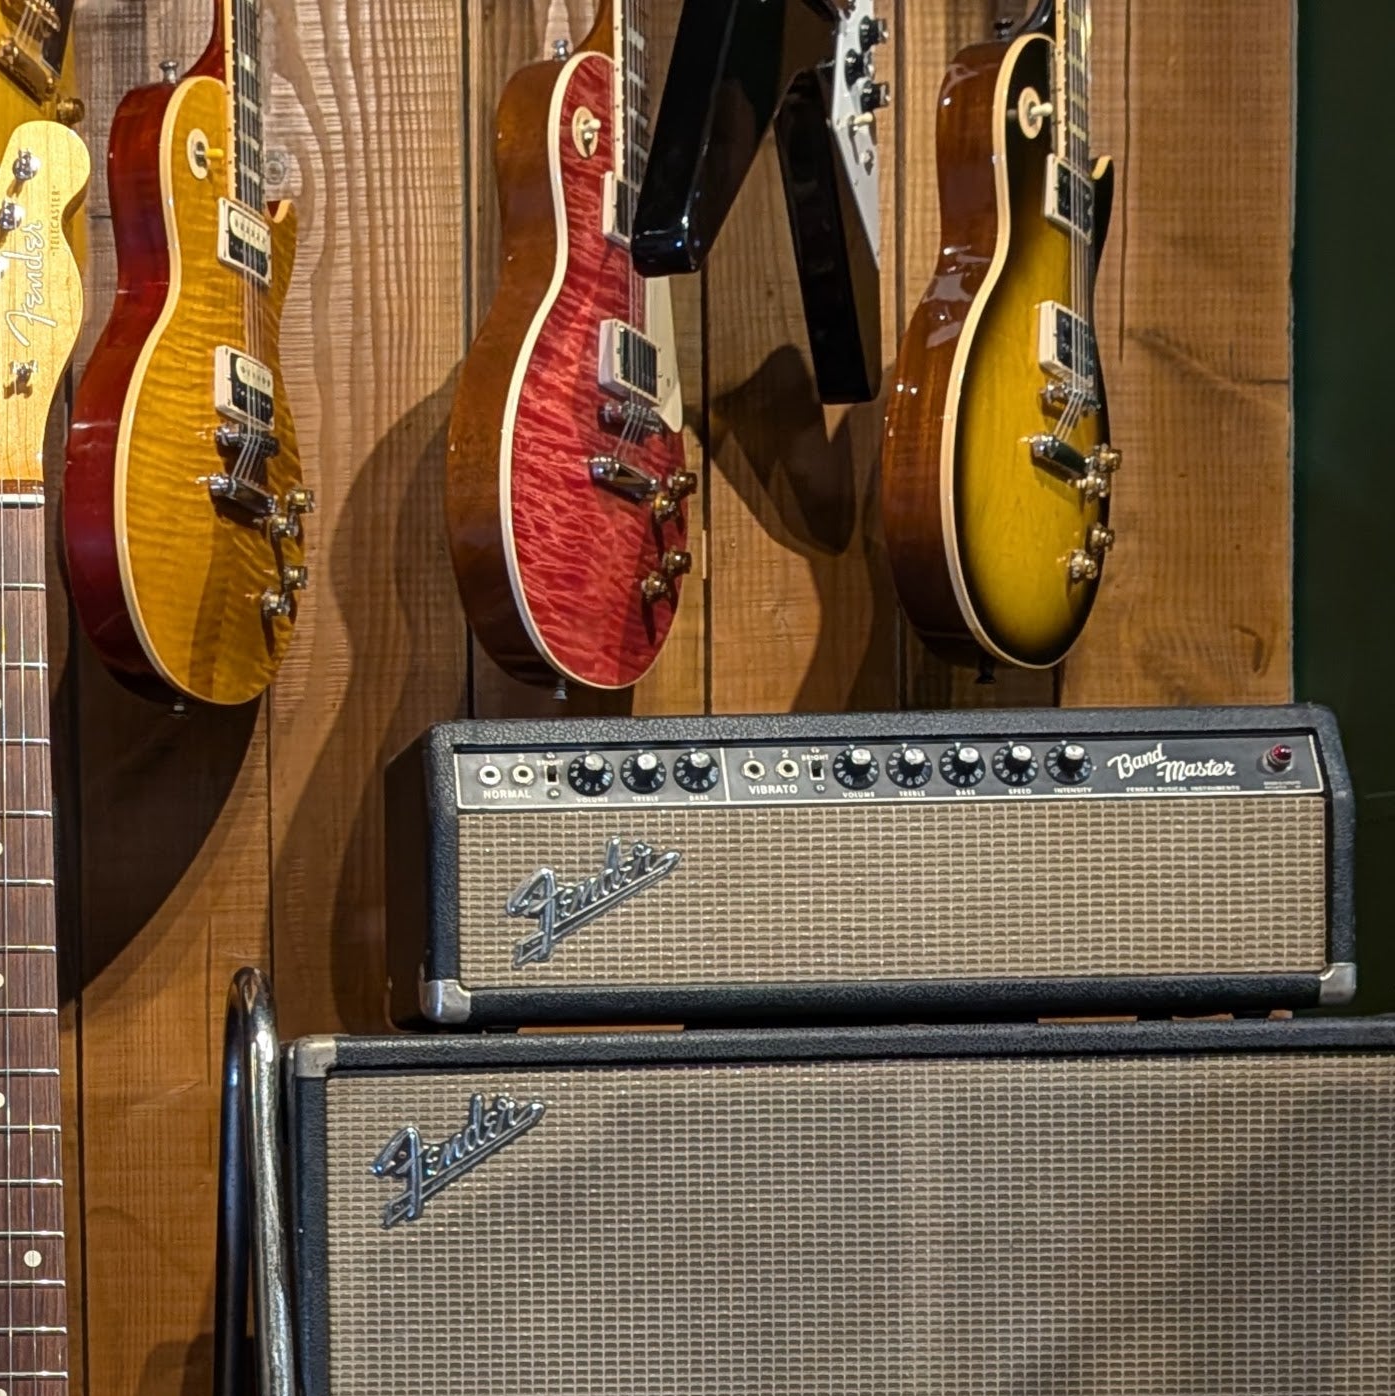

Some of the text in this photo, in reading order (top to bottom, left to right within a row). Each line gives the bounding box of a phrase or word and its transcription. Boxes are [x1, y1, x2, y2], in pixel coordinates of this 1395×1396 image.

[1, 219, 58, 347] Fender
[483, 790, 532, 799] NORMAL
[748, 784, 798, 795] VIBRATO
[1107, 742, 1236, 783] Band Master
[506, 834, 682, 968] Fender
[371, 1092, 546, 1230] Fender
